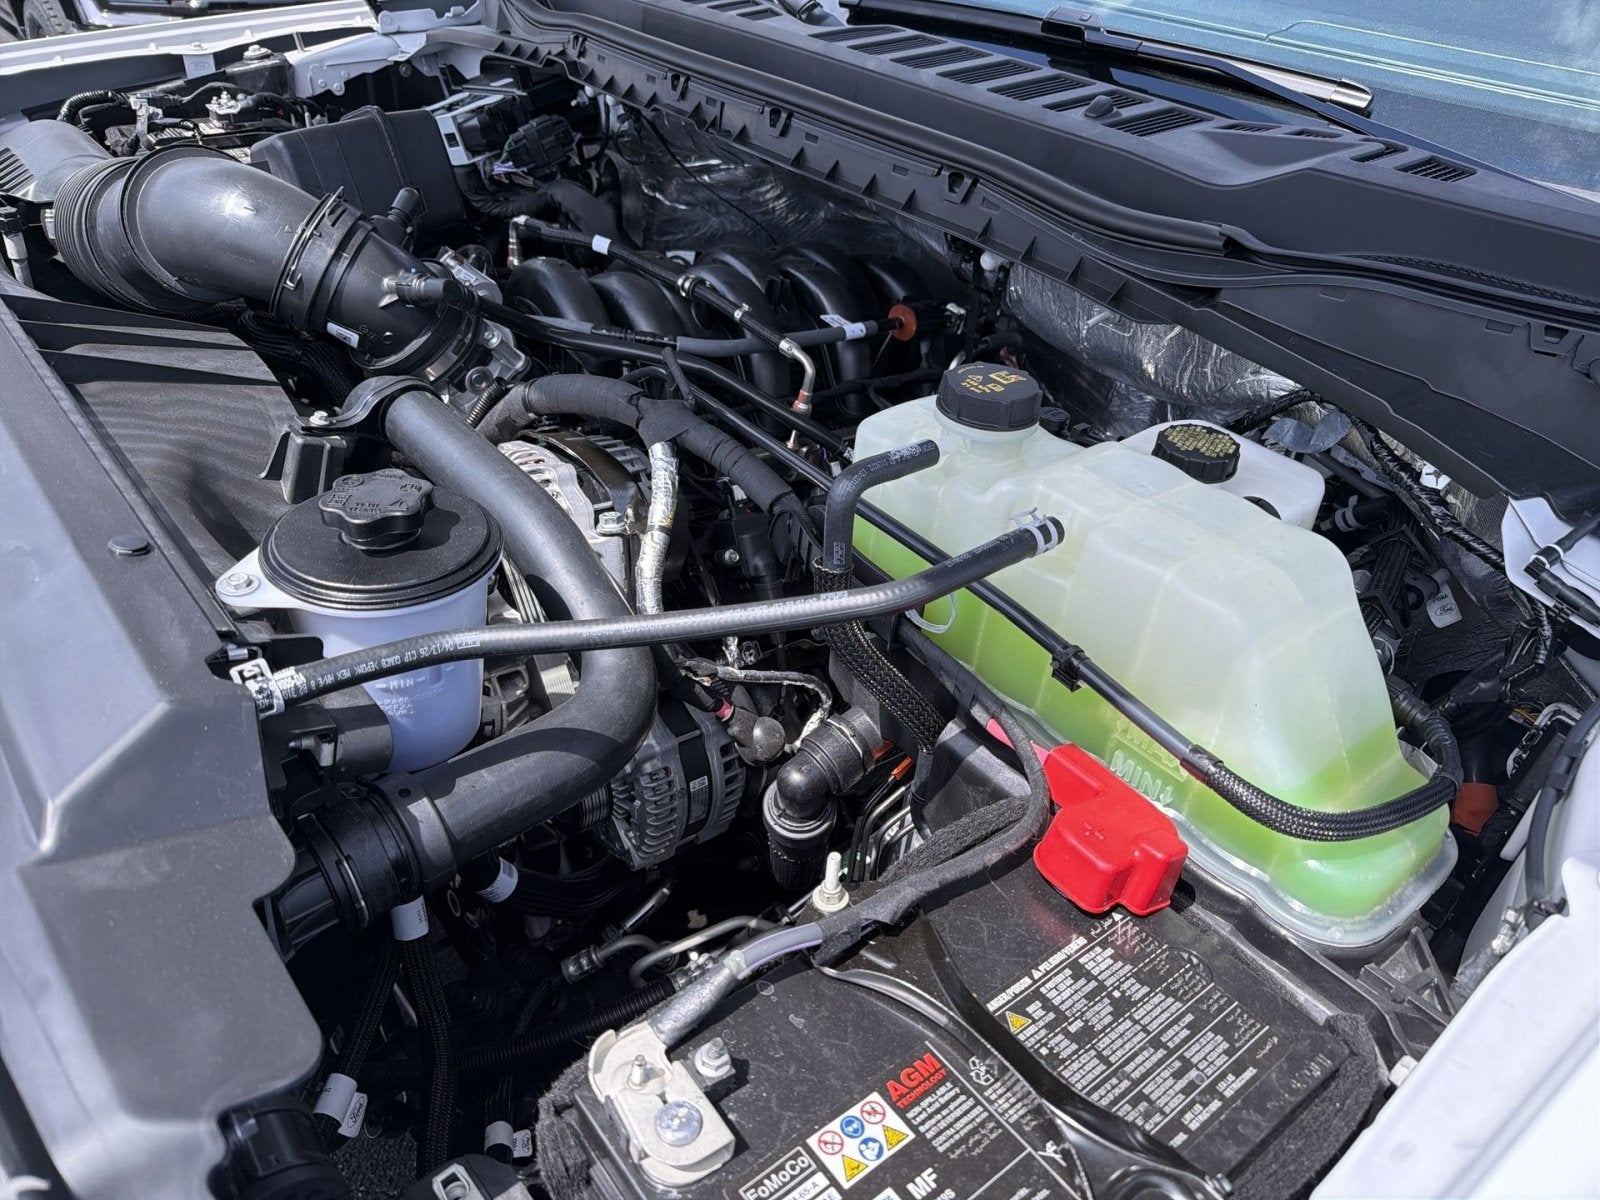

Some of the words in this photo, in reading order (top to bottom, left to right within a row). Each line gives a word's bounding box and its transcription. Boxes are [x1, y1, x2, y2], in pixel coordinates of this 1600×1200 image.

[390, 678, 414, 690] MIN
[1109, 749, 1161, 800] MIN
[986, 974, 1032, 1012] ANGER/POISON
[886, 1053, 942, 1102] AGM
[896, 1068, 948, 1109] TECHNOLOGY
[905, 1081, 953, 1119] NON-SPILLABLE
[745, 1153, 811, 1200] FoMoCo
[905, 1166, 942, 1200] MF
